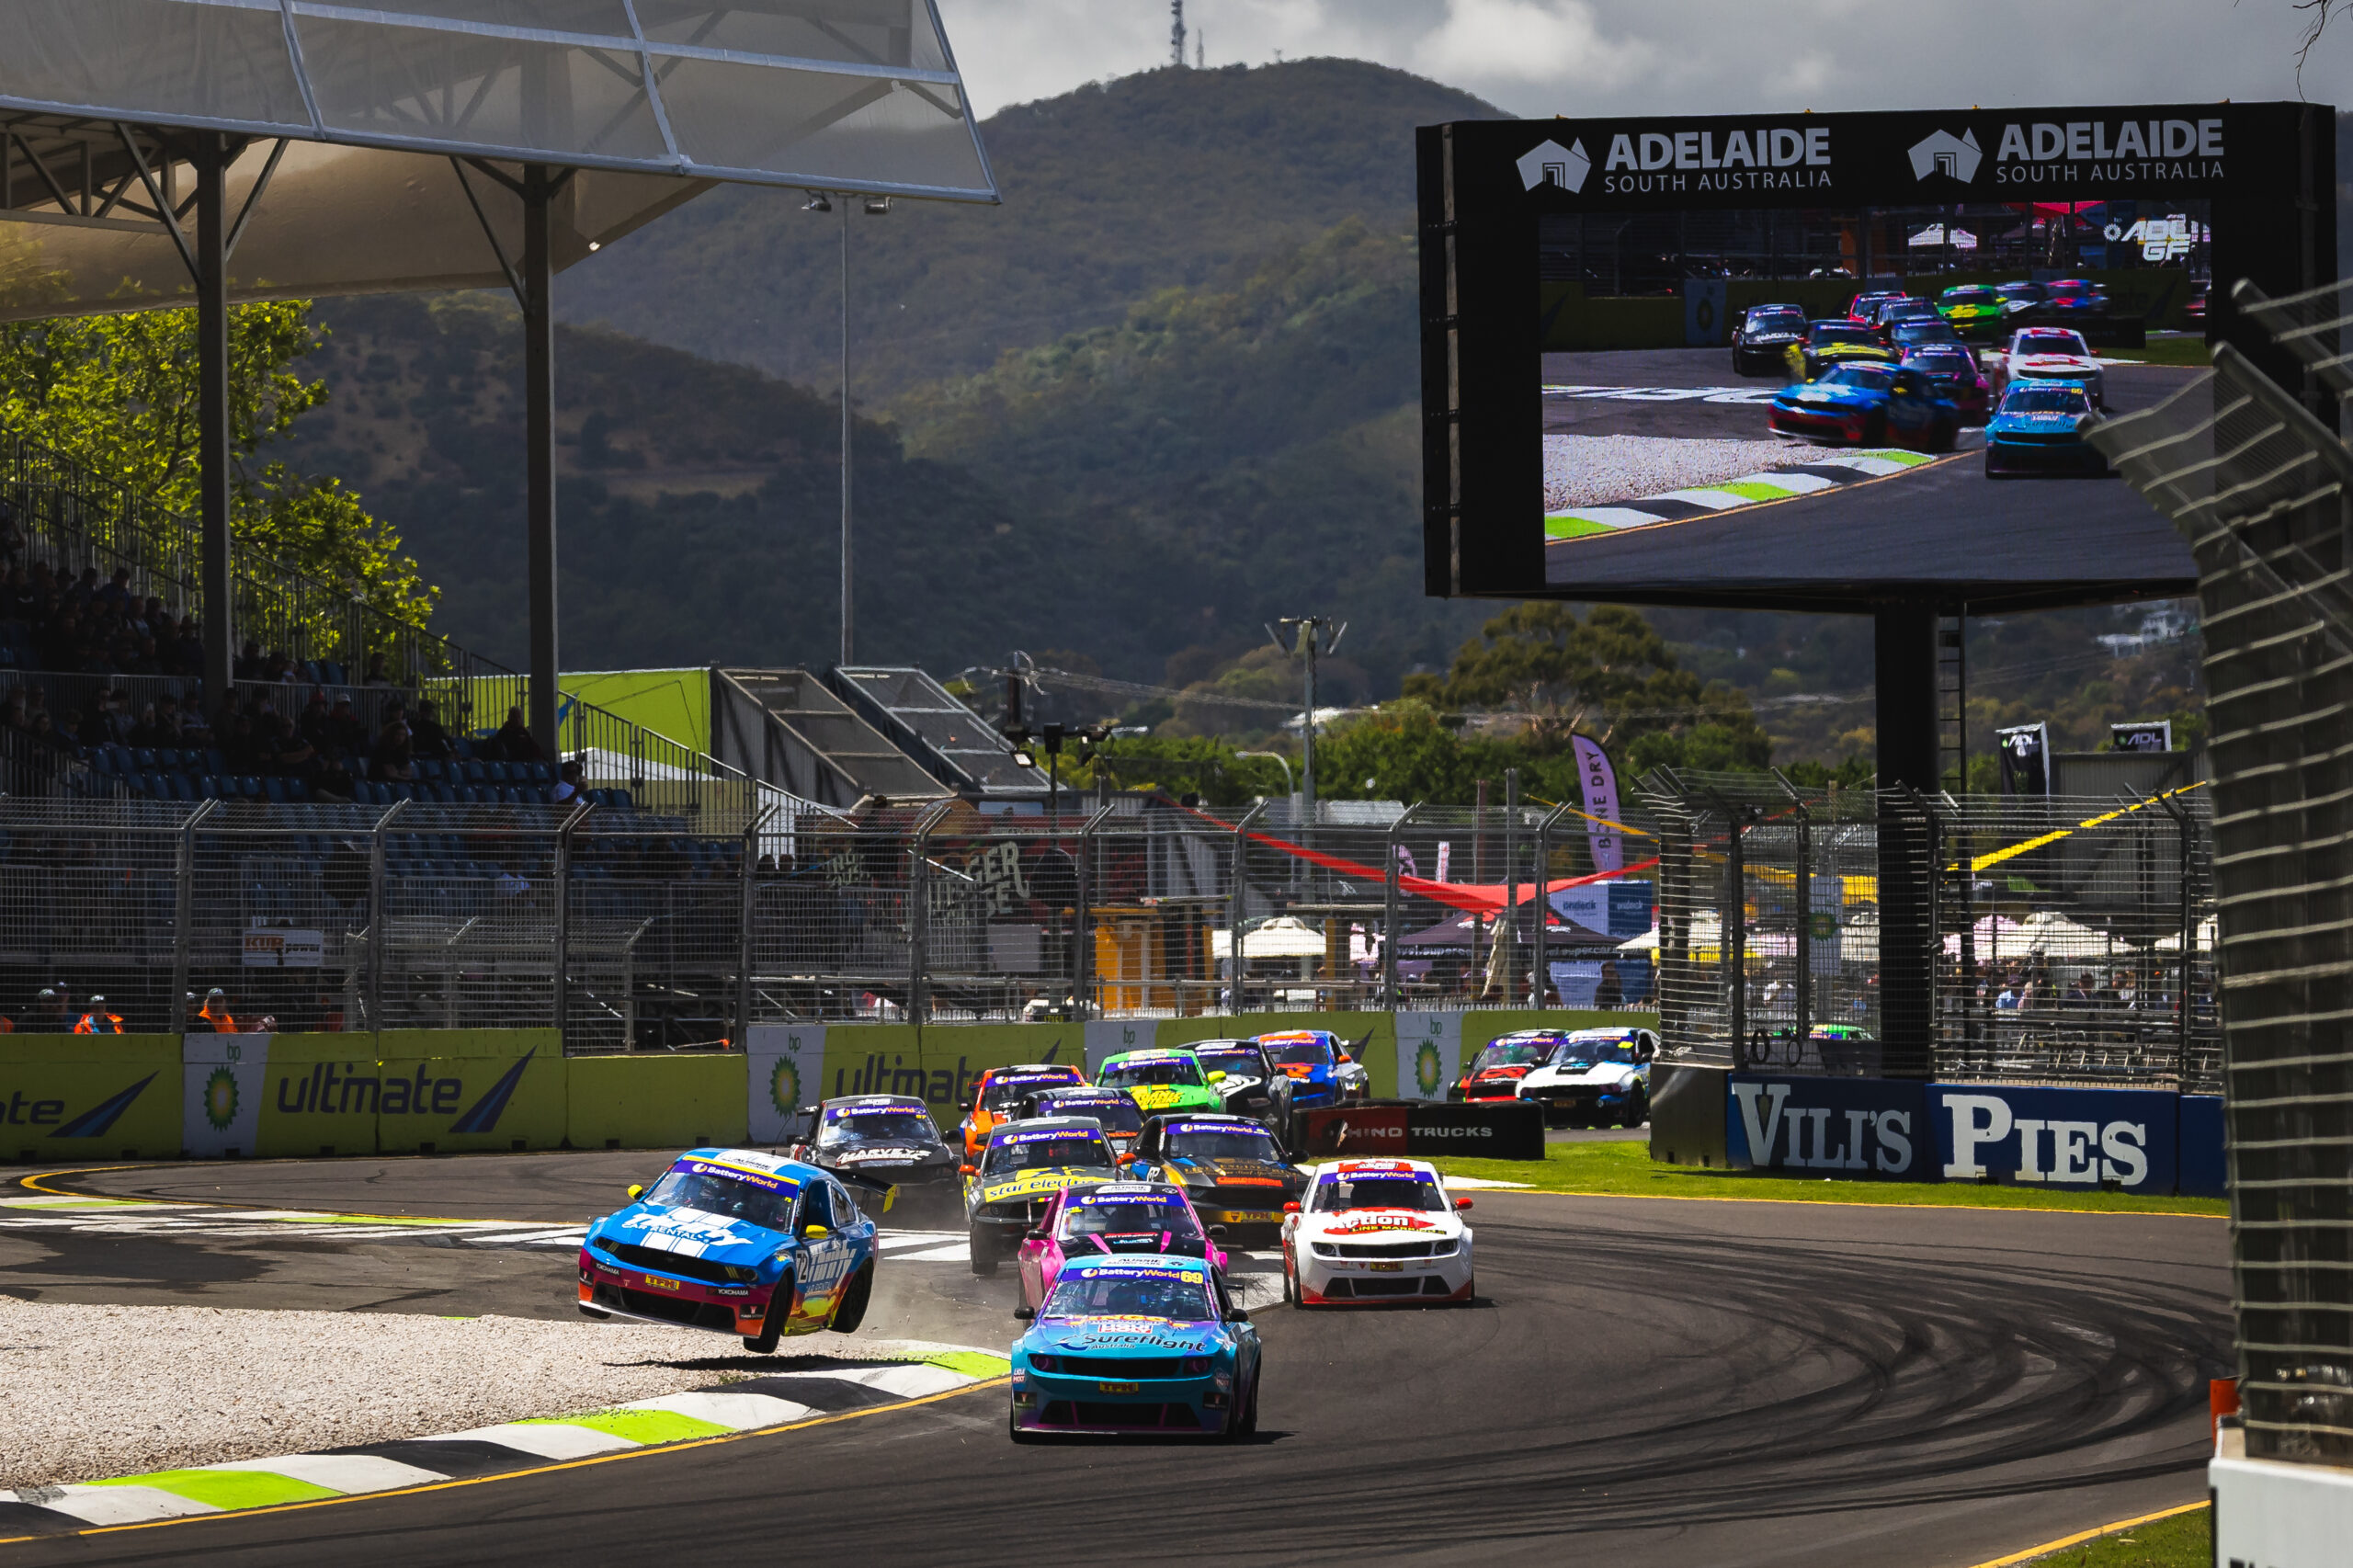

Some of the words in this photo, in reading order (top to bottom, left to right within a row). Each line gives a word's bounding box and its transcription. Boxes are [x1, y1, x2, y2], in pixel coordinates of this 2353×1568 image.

[1605, 127, 1832, 171] ADELAIDE
[1996, 119, 2224, 162] ADELAIDE
[1605, 174, 1687, 193] SOUTH
[1698, 170, 1832, 191] AUSTRALIA
[1996, 165, 2078, 184] SOUTH
[2090, 161, 2224, 181] AUSTRALIA
[1586, 751, 1605, 787] DRY
[1123, 1024, 1136, 1048] bp
[1430, 1014, 1443, 1038] bp
[226, 1041, 242, 1061] bp
[788, 1033, 801, 1054] bp
[278, 1062, 462, 1114] ultimate
[1018, 1130, 1089, 1142] BatteryWorld
[1411, 1126, 1494, 1138] TRUCKS
[1732, 1082, 1912, 1173] VILI'S
[1942, 1094, 2148, 1186] PIES
[707, 1165, 779, 1190] BatteryWorld
[1350, 1171, 1416, 1181] BatteryWorld
[989, 1182, 1027, 1198] star
[1097, 1196, 1167, 1204] BatteryWorld
[596, 1262, 620, 1276] YOKOHAMA
[797, 1252, 808, 1280] 72
[1098, 1267, 1180, 1278] BatteryWorld
[1180, 1270, 1204, 1285] 69
[717, 1289, 749, 1297] YOKOHAMA
[1082, 1332, 1208, 1354] Sureflight
